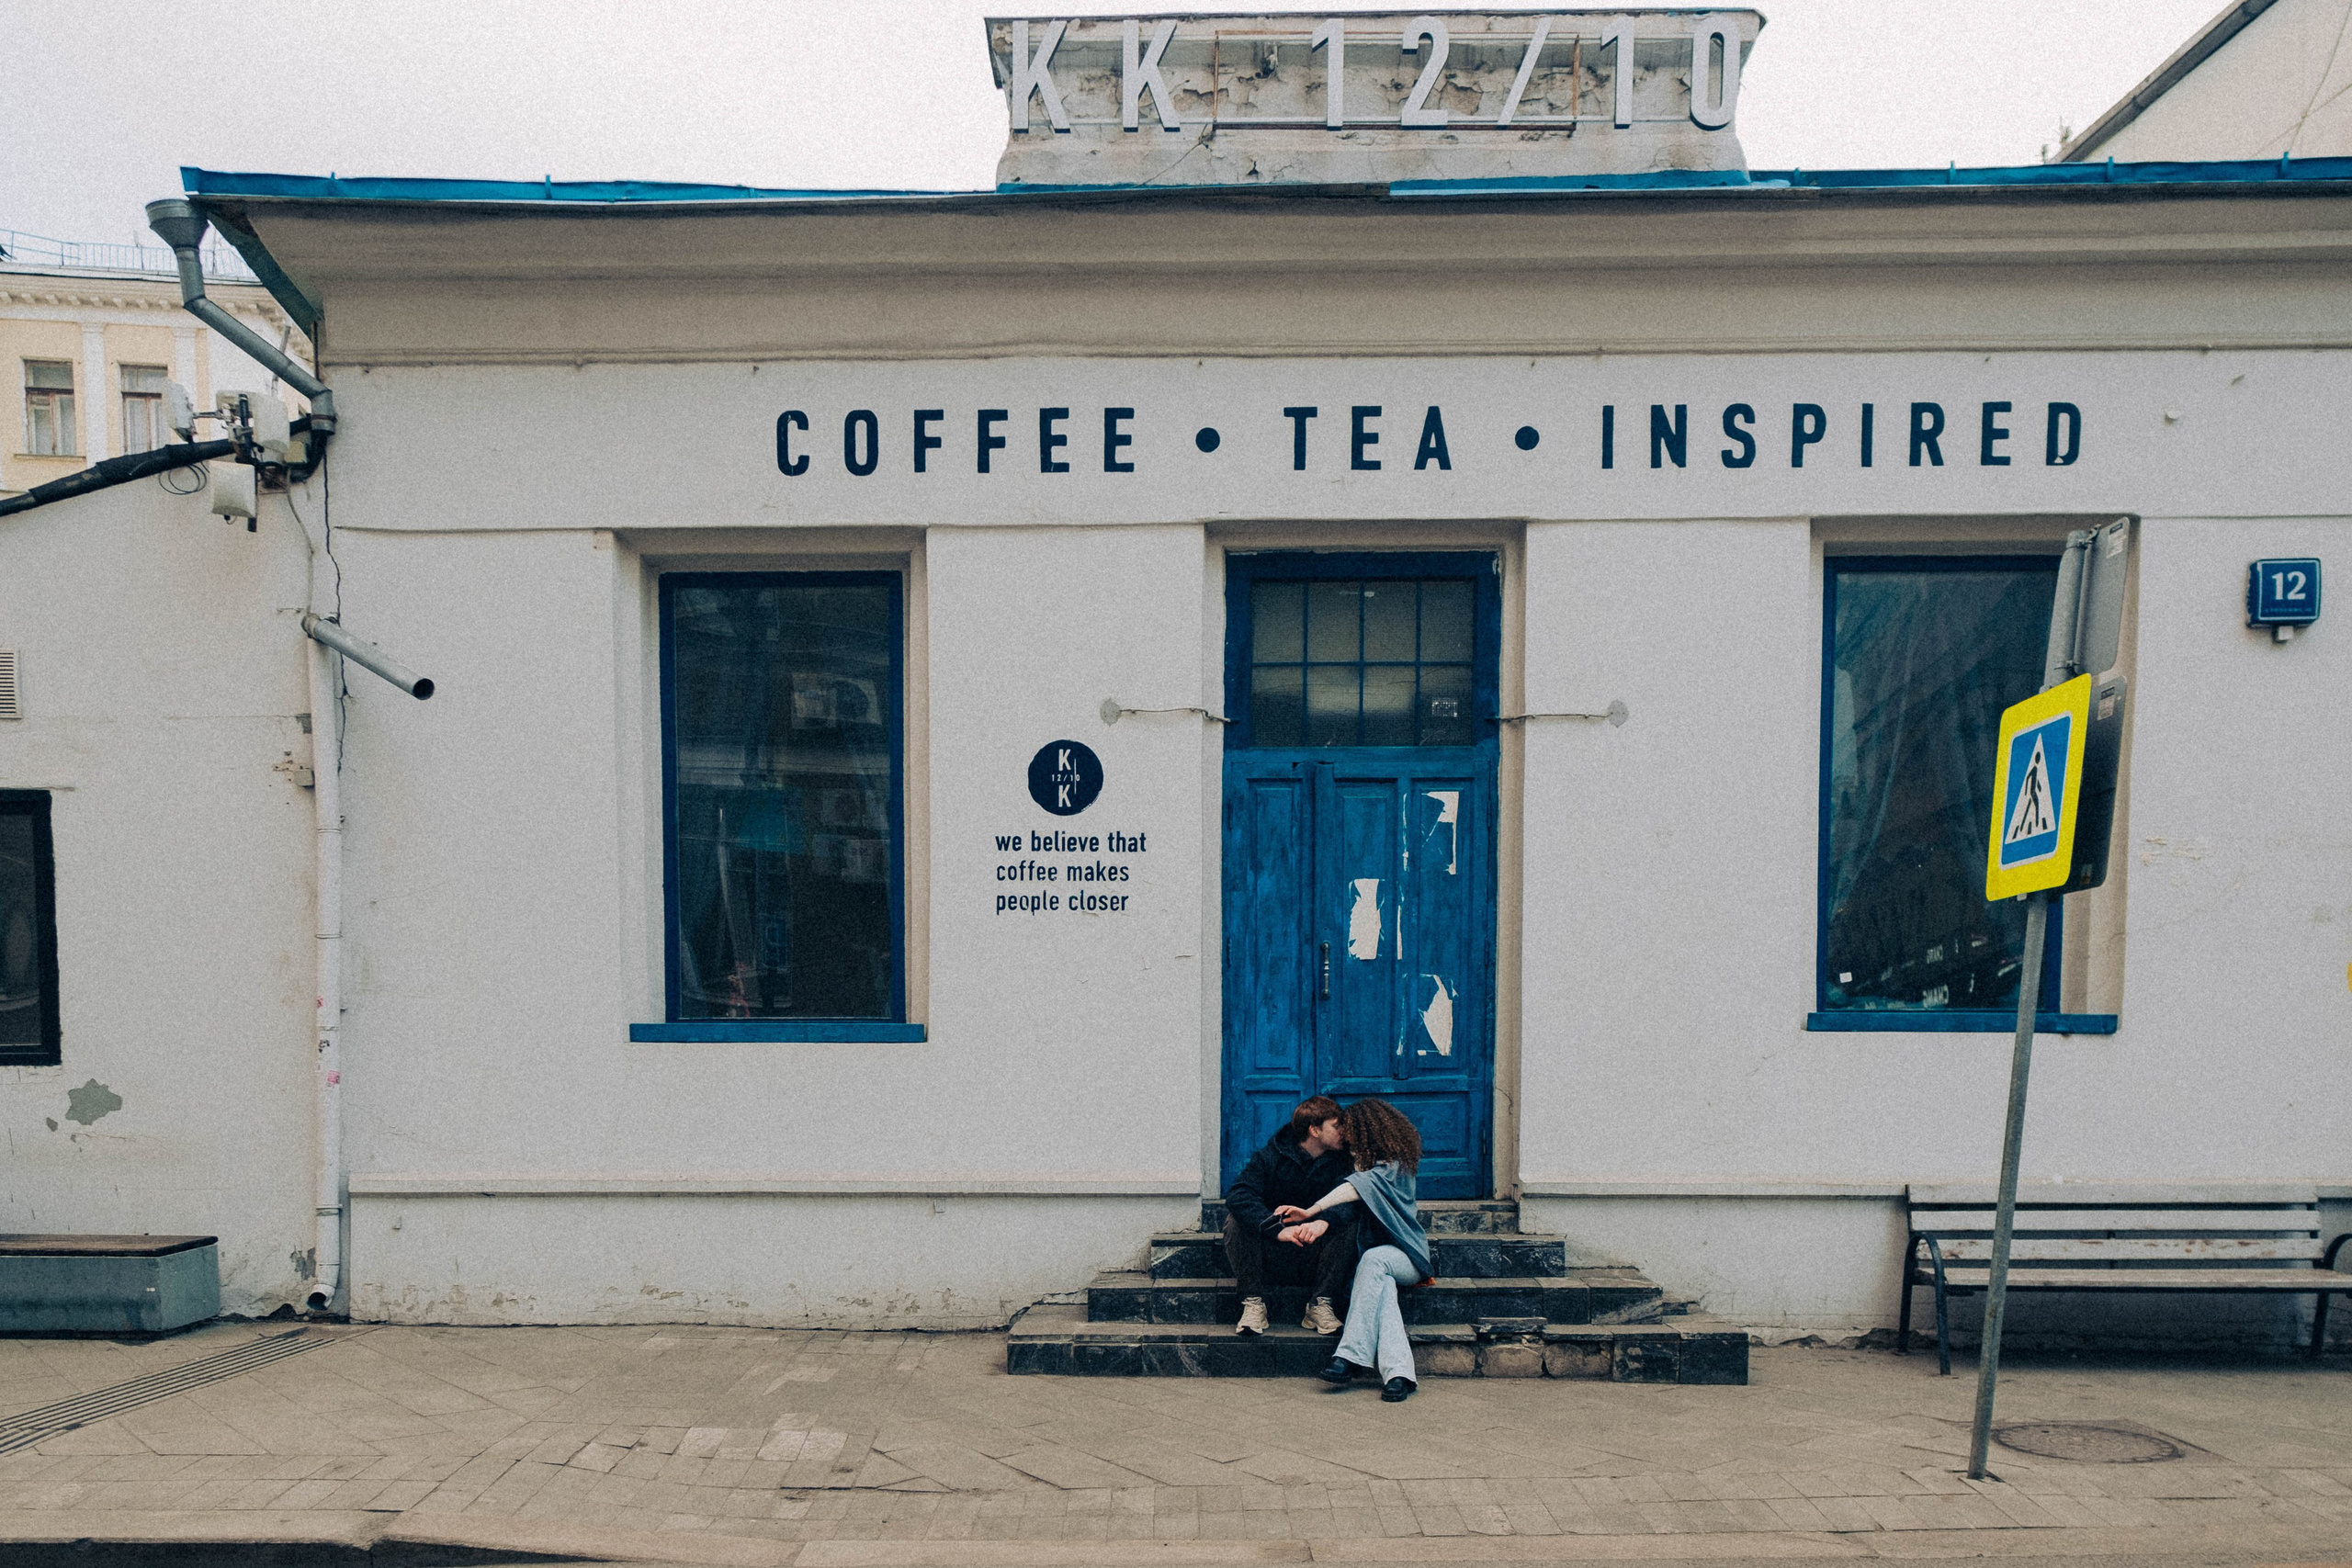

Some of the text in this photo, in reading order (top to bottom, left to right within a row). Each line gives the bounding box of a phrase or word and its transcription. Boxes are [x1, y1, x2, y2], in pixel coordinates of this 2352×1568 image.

[1311, 16, 1741, 130] 12/10
[775, 400, 2082, 477] COFFEE TEA INSPIRED
[2271, 570, 2307, 601] 12
[1058, 749, 1071, 772] K
[1051, 773, 1080, 783] 12/10
[1057, 784, 1071, 807] K
[995, 830, 1147, 852] we believe that
[996, 860, 1129, 882] coffee makes
[996, 889, 1129, 916] people closer
